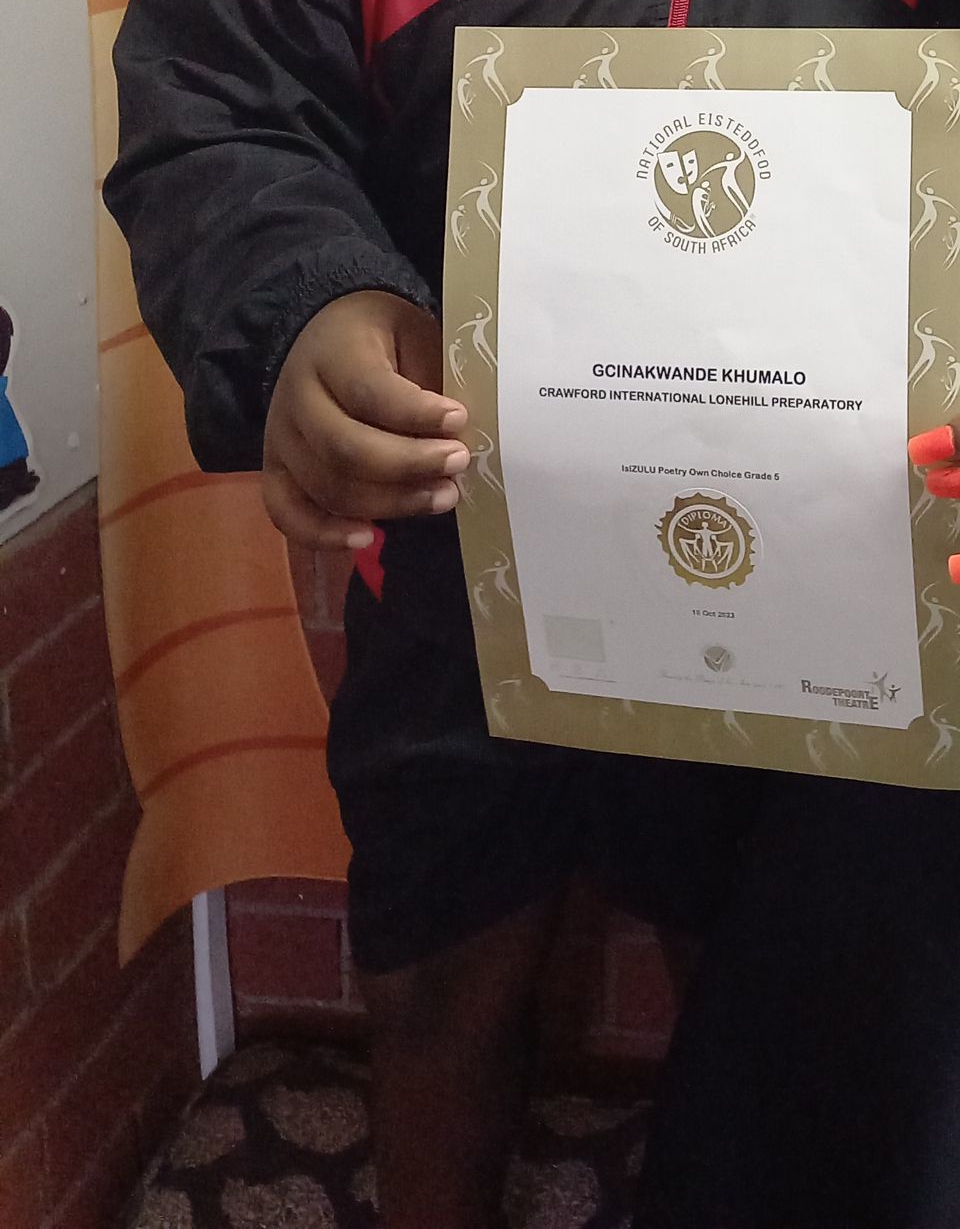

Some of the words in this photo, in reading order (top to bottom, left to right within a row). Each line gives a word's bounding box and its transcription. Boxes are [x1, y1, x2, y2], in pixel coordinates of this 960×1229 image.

[636, 115, 692, 180] NATIONAL
[698, 112, 772, 180] EISTEDDFOD
[648, 216, 665, 232] OF
[663, 231, 707, 255] SOUTH
[712, 218, 757, 254] AFRICA
[592, 363, 718, 382] GCINAKWANDE
[721, 368, 807, 385] KHUMALO
[538, 387, 607, 401] CRAWFORD
[609, 389, 706, 405] INTERNATIONAL
[708, 393, 769, 408] LONEHILL
[771, 396, 863, 411] PREPARATORY
[621, 464, 656, 474] IsiZULU
[658, 466, 687, 477] Poetry
[689, 468, 710, 476] Own
[711, 469, 742, 479] Choice
[744, 471, 772, 480] Grade
[773, 472, 780, 481] 5
[680, 511, 728, 529] DIPLOMA
[801, 679, 870, 699] ROODEPOORT
[832, 696, 879, 710] THEATRE
